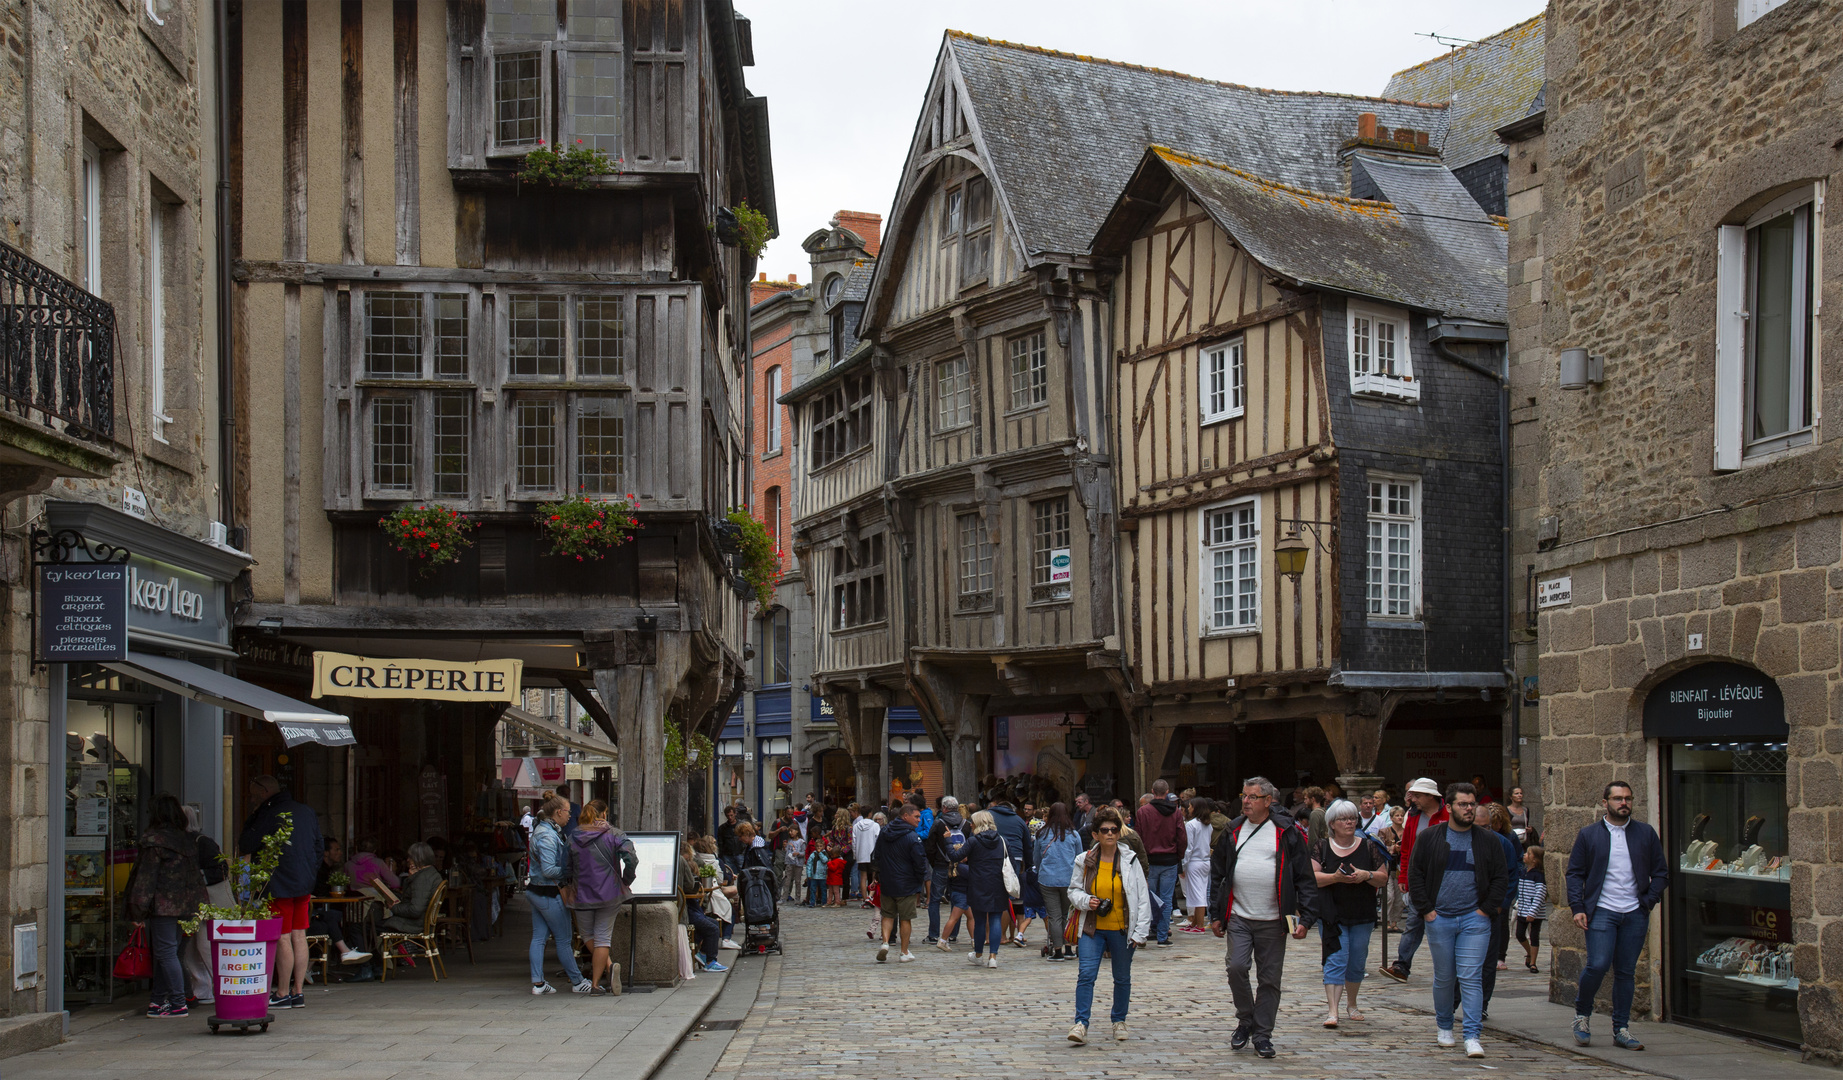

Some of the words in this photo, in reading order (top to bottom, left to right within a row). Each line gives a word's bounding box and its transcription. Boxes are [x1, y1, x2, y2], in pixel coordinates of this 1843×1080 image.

[46, 571, 62, 582] ty
[1548, 582, 1561, 590] PLACE
[1539, 596, 1547, 604] DES
[1549, 591, 1571, 602] MERCIERS
[61, 602, 105, 612] argent
[55, 623, 112, 632] celtiques
[60, 636, 107, 645] pierres
[1693, 638, 1698, 646] 9
[50, 643, 117, 651] naturelles
[329, 663, 506, 693] CRÊPERIE
[1670, 689, 1709, 703] BIENFAIT
[1719, 684, 1763, 701] LÉVÊQUE
[1698, 708, 1733, 721] Bijoutier
[1406, 751, 1459, 760] BOUQUINERIE
[1417, 768, 1447, 776] CENTRE
[1751, 909, 1778, 929] ice
[1752, 929, 1778, 940] watch
[221, 948, 263, 956] BIJOUX
[221, 962, 263, 971] ARGENT
[223, 977, 264, 985] PIERRES
